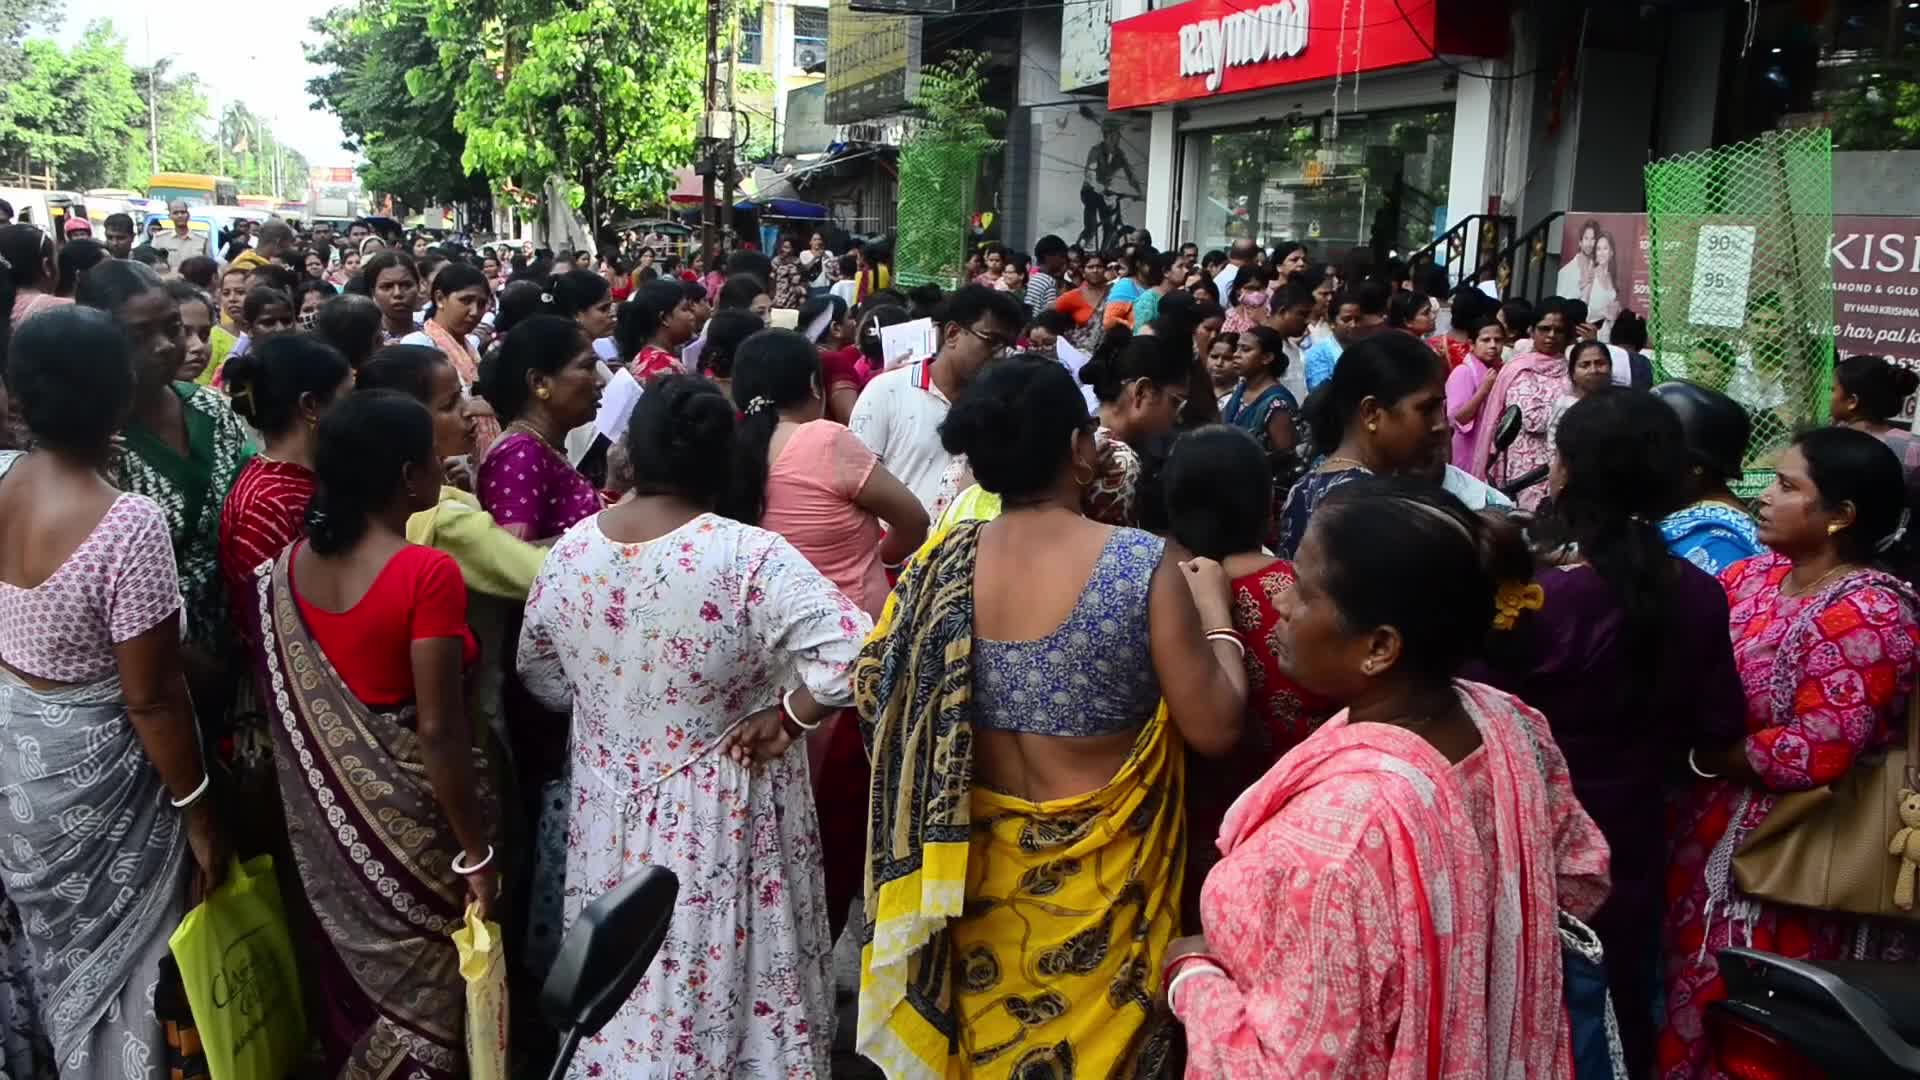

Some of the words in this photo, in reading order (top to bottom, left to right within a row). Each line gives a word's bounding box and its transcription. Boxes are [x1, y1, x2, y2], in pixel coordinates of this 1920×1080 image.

[1178, 0, 1309, 91] Raymond
[1875, 284, 1883, 293] &
[1887, 285, 1919, 296] GOLD
[1844, 303, 1857, 312] BY
[1843, 323, 1875, 338] har
[1873, 327, 1906, 344] pal
